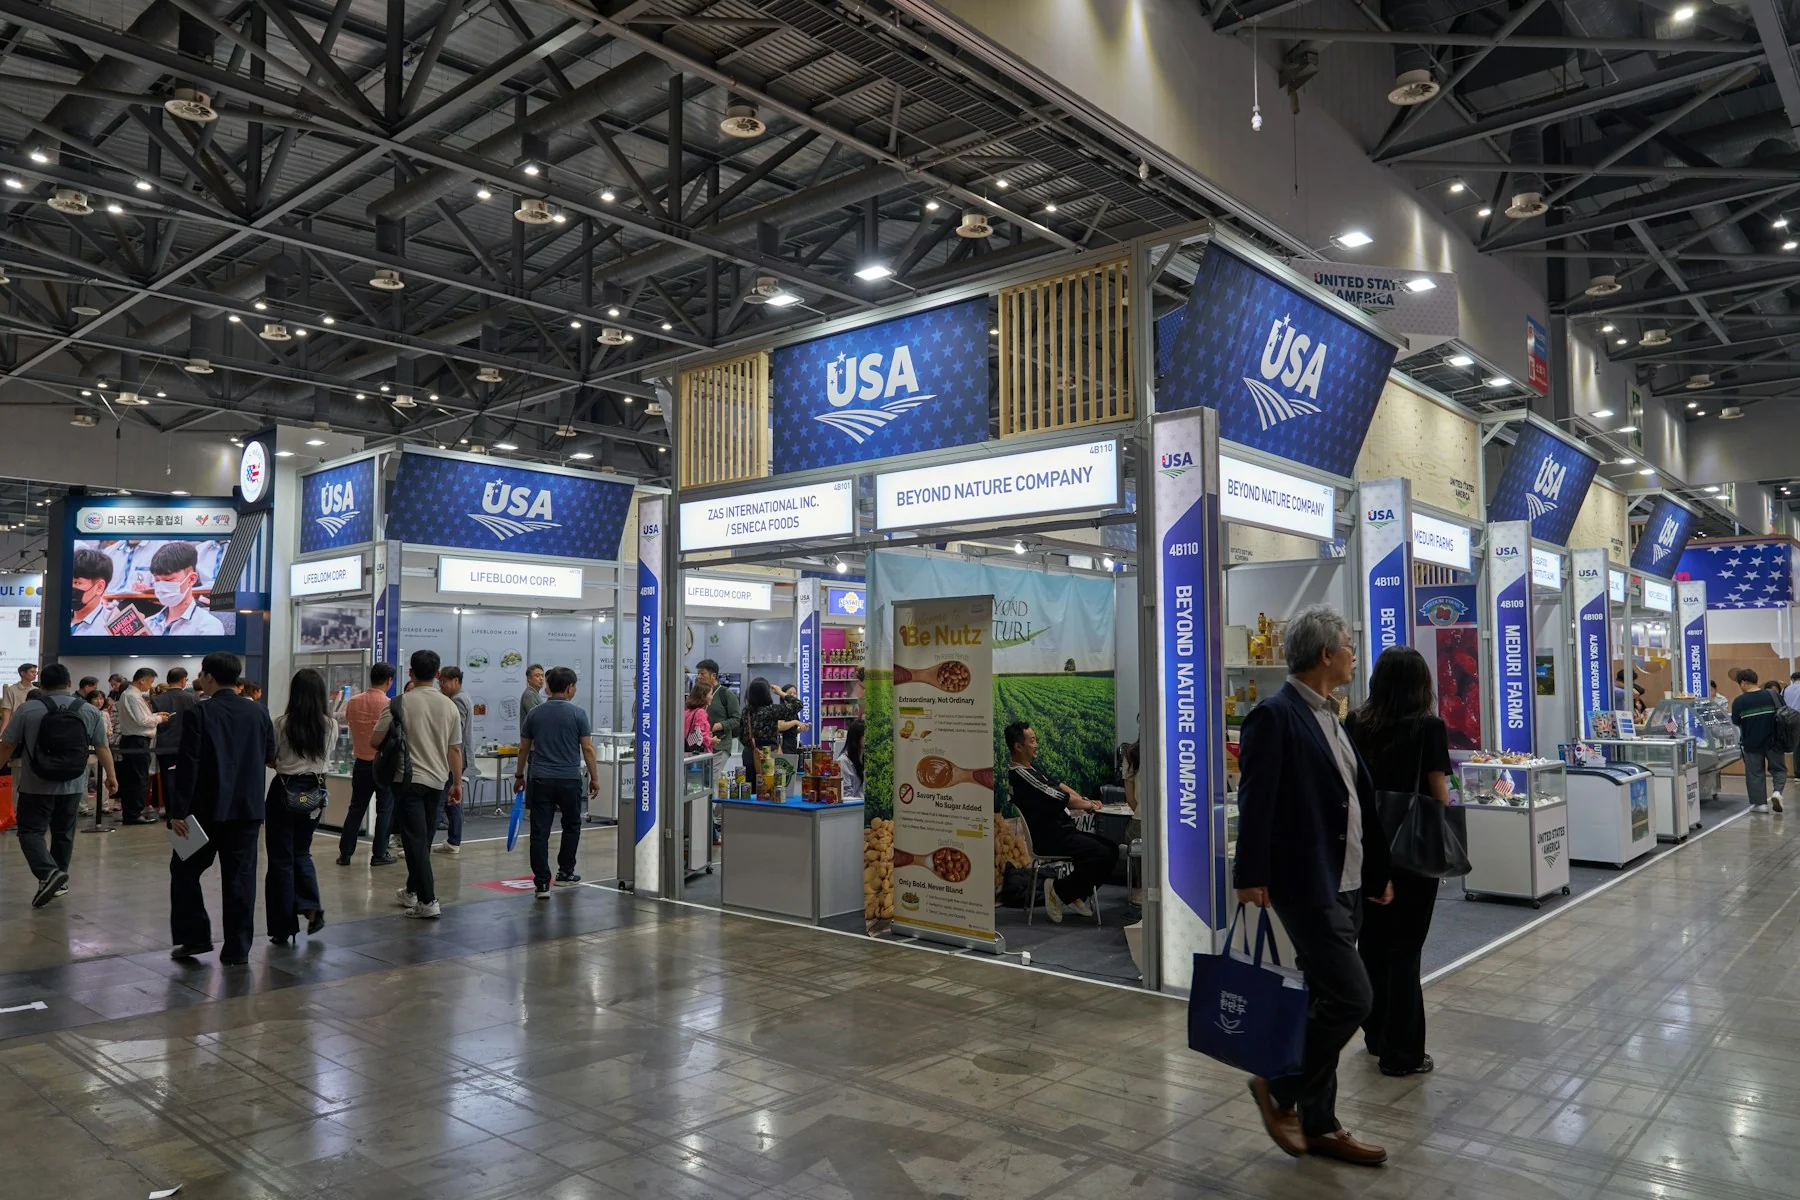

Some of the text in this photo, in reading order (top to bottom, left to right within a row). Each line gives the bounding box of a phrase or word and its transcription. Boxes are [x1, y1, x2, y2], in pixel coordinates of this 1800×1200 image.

[1314, 271, 1396, 291] UNITED STAT
[1336, 290, 1395, 306] AMERICA
[1260, 313, 1328, 400] USA
[826, 345, 920, 407] USA
[1089, 443, 1113, 455] 4B110
[1162, 451, 1193, 468] USA
[833, 482, 851, 491] 4B101
[896, 465, 1093, 507] BEYOND NATURE COMPANY
[1534, 453, 1567, 501] USA
[321, 481, 355, 515] USA
[482, 478, 552, 521] USA
[708, 495, 820, 521] ZAS INTERNATIONAL INC.
[1227, 478, 1325, 518] BEYOND NATURE COMPANY
[107, 515, 183, 526] 미국육류수출협회
[1368, 508, 1395, 521] USA
[643, 524, 659, 535] USA
[725, 515, 800, 537] / SENECA FOODS
[1658, 513, 1680, 548] USA
[1169, 542, 1199, 557] 4B110
[1413, 531, 1454, 552] MEDURI FARMS
[1495, 547, 1519, 556] USA
[303, 569, 348, 585] LIFEBLOOM CORP.
[470, 571, 557, 587] LIFEBLOOM CORP.
[1374, 576, 1400, 587] 4B110
[1578, 569, 1599, 577] USA
[640, 586, 656, 596] 4B101
[687, 587, 752, 600] LIFEBLOOM CORP.
[800, 594, 810, 602] USA
[993, 598, 1028, 617] YOND
[1500, 599, 1524, 608] 4B109
[111, 611, 137, 635] AMERICAN
[642, 615, 651, 635] ZAS
[1583, 613, 1603, 621] 4B108
[906, 623, 982, 647] Be Nutz
[376, 631, 384, 663] LIFEB
[1589, 633, 1598, 660] ALASKA
[1691, 645, 1700, 671] PACIFIC
[642, 637, 650, 708] INTERNATIONAL
[1504, 624, 1524, 729] MEDURI FARMS
[1590, 660, 1600, 689] SEAFOOD
[801, 644, 810, 723] LIFEBLOOM CORP.
[949, 696, 975, 706] Ordinary
[1175, 585, 1197, 828] BEYOND NATURE COMPANY
[641, 740, 650, 778] SENECA
[641, 780, 650, 812] FOODS
[916, 791, 954, 802] Savory Taste,
[934, 800, 982, 812] No Sugar Added
[898, 878, 912, 888] Only
[927, 883, 945, 892] Never
